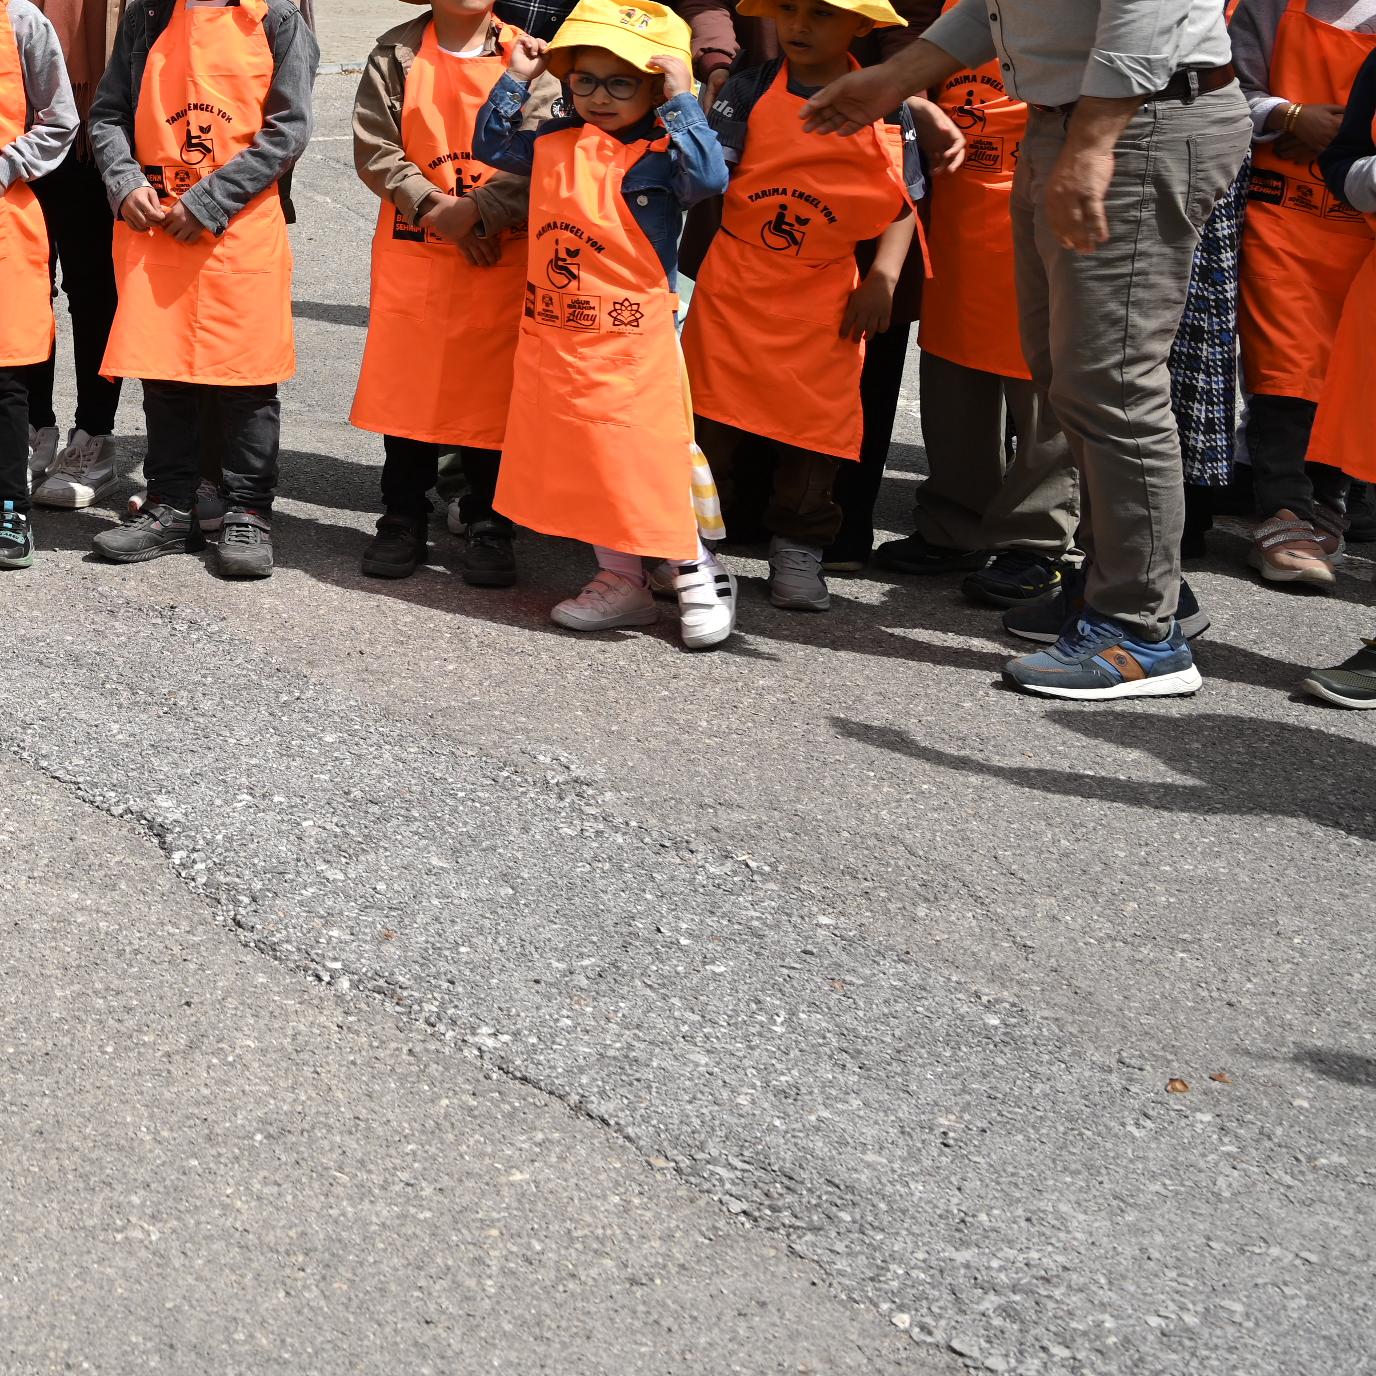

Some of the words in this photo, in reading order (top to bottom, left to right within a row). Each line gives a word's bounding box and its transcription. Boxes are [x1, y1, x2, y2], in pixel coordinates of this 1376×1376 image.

[188, 103, 214, 114] ENGEL
[216, 108, 233, 124] YOK
[428, 153, 459, 170] TARIMA
[748, 188, 788, 203] TARIMA
[791, 189, 822, 208] ENGEL
[821, 206, 838, 224] YOK
[536, 221, 560, 240] TARIMA
[560, 222, 584, 240] ENGEL
[585, 236, 606, 254] YOK
[566, 310, 598, 326] Altay
